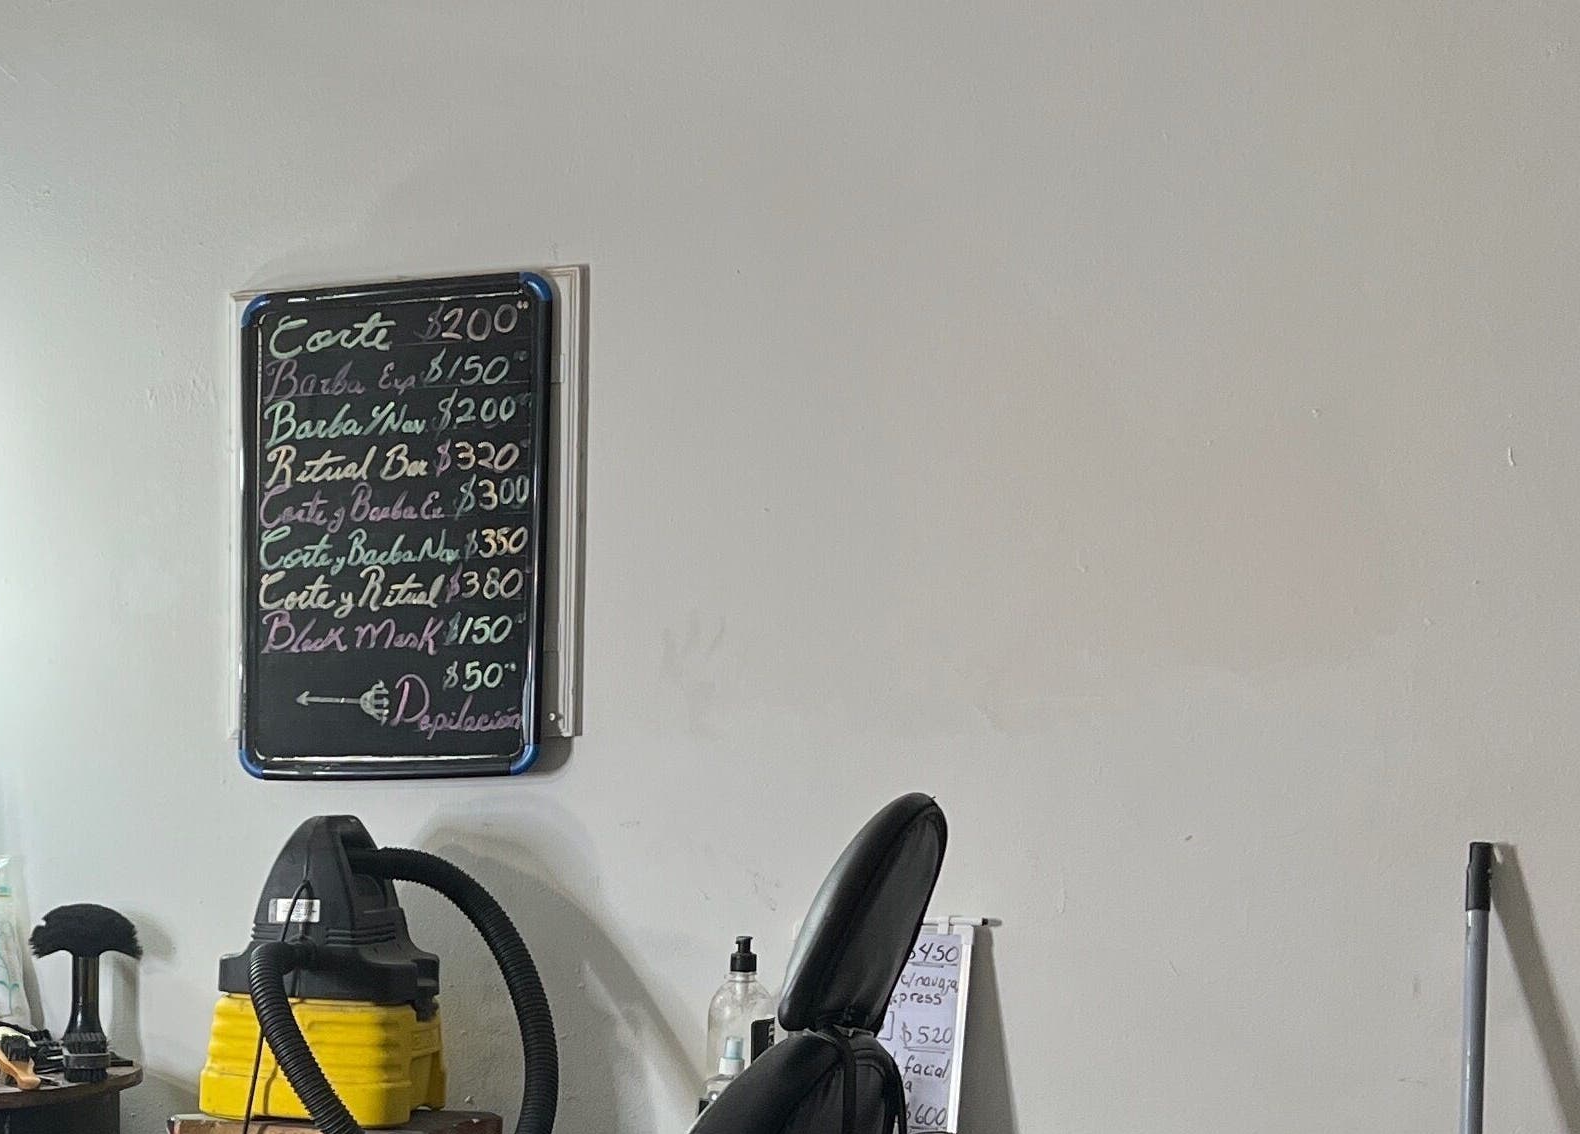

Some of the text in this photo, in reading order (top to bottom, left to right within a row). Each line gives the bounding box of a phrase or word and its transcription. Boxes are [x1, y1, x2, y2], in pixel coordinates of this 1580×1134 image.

[269, 311, 397, 359] Corte
[266, 358, 366, 402] Barba
[264, 400, 363, 449] Barba
[266, 444, 377, 489] Ritual
[351, 482, 418, 521] Barba
[455, 474, 530, 520] $300
[260, 525, 330, 571] Corte
[259, 571, 336, 611] Corte
[334, 588, 354, 619] y
[359, 565, 446, 612] Ritual
[260, 611, 348, 654] Black
[355, 614, 445, 656] Mask
[900, 1020, 954, 1047] $520
